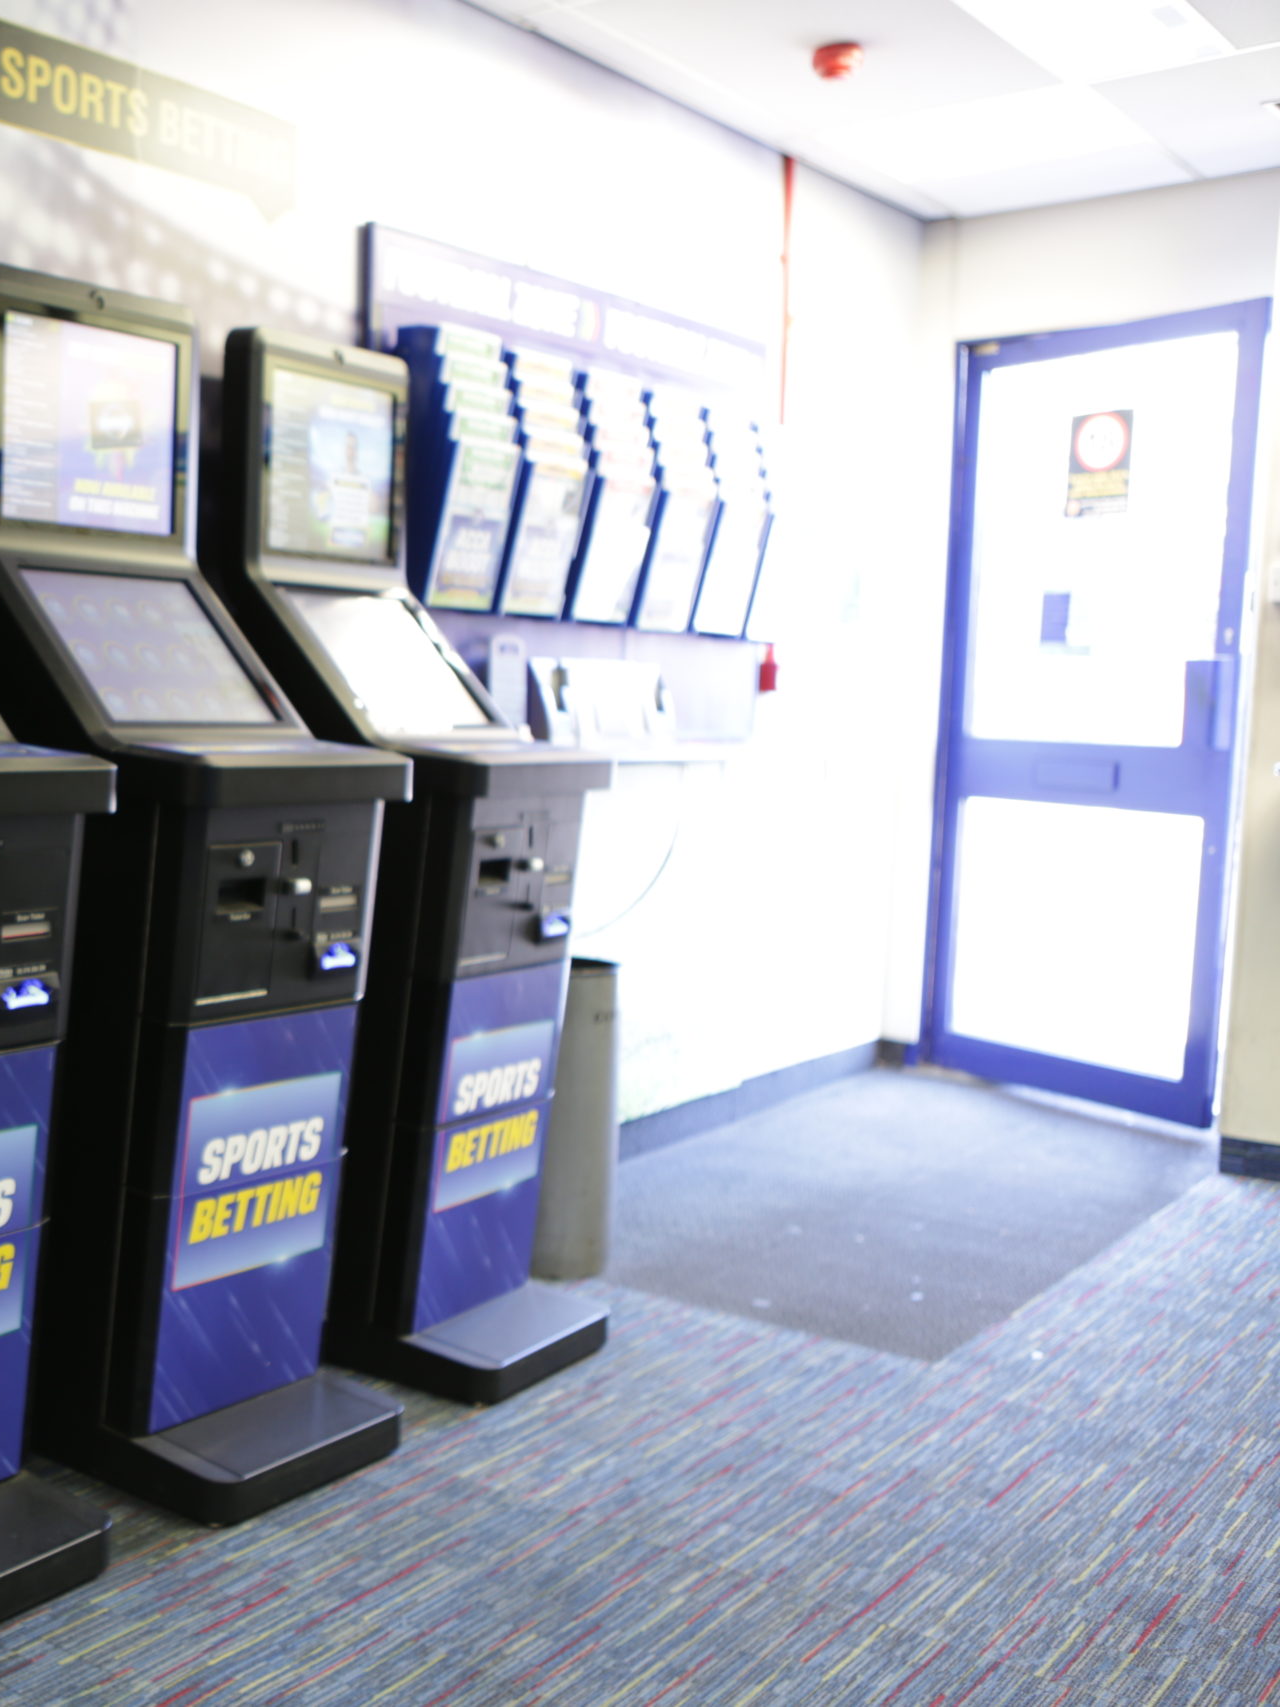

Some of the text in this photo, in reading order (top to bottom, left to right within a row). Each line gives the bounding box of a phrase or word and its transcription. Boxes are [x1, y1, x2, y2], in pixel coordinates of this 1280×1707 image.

[0, 47, 149, 137] SPORTS
[453, 1057, 542, 1115] SPORTS
[197, 1116, 324, 1185] SPORTS
[445, 1109, 539, 1173] BETTING
[187, 1171, 323, 1245] BETTING
